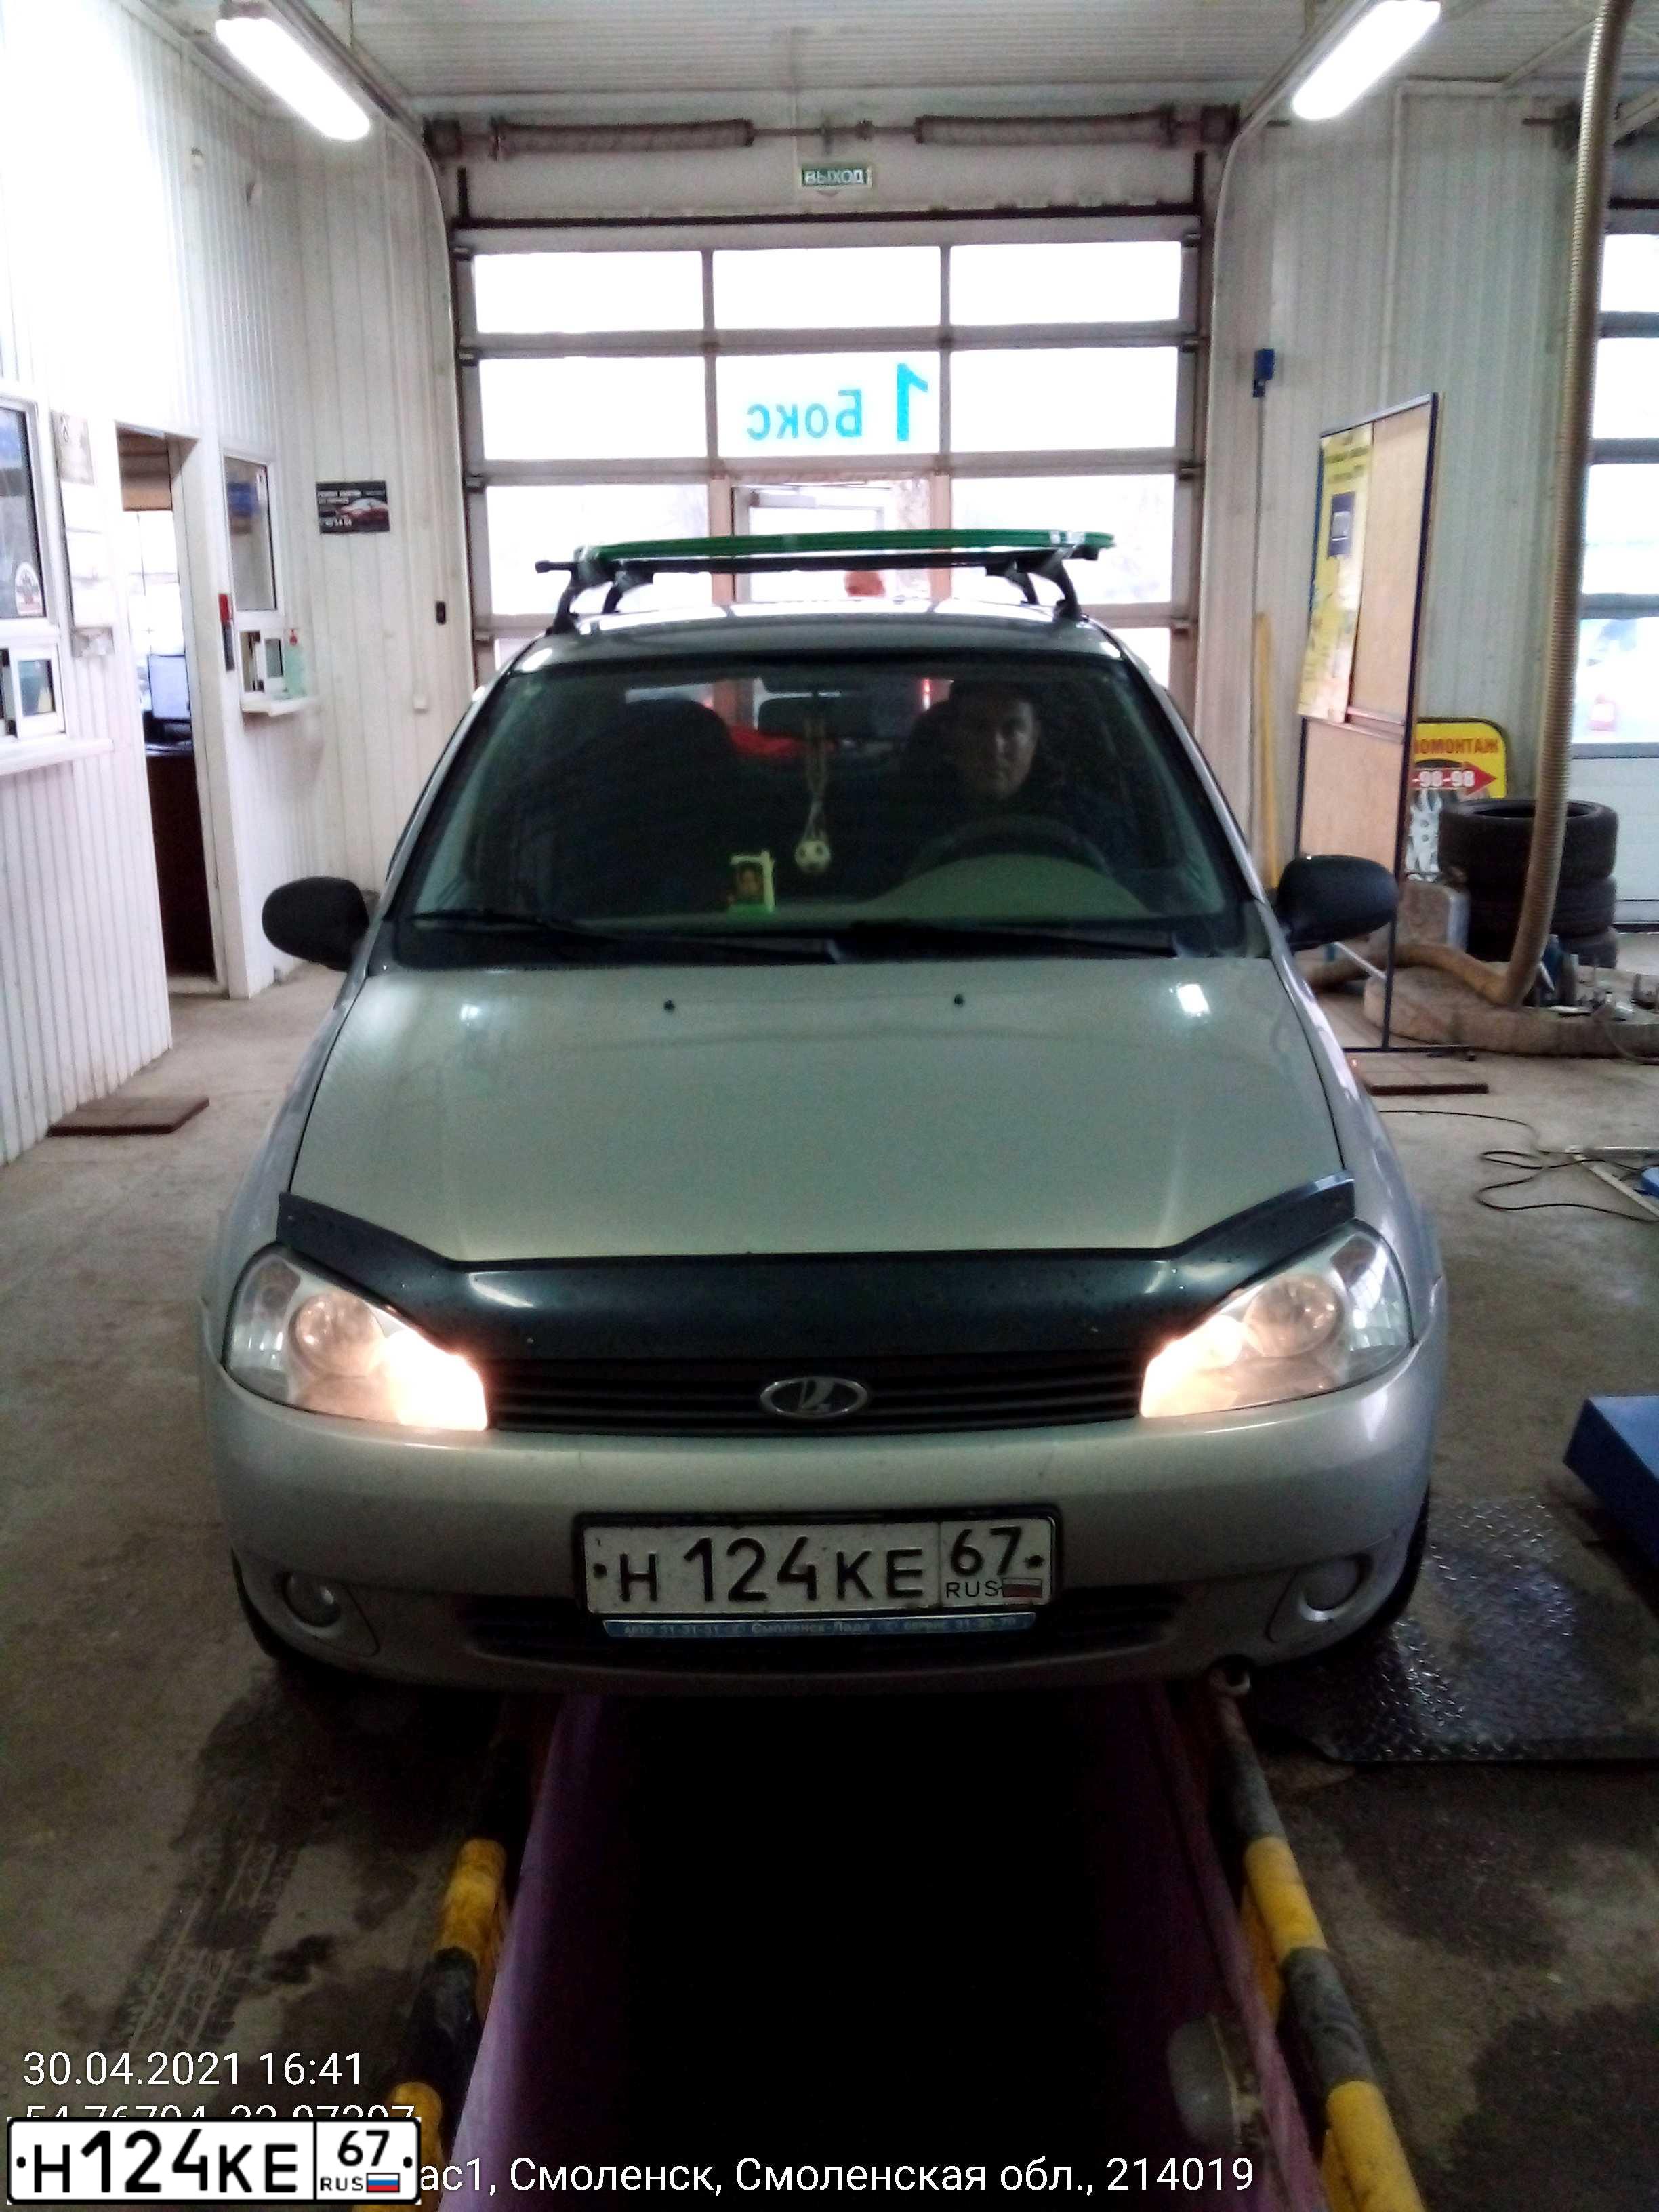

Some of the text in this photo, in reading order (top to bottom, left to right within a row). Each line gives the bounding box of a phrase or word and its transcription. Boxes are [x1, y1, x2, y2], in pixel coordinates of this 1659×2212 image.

[805, 169, 864, 184] ВЫХОД
[951, 1526, 1021, 1576] 67
[946, 1580, 999, 1598] RUS
